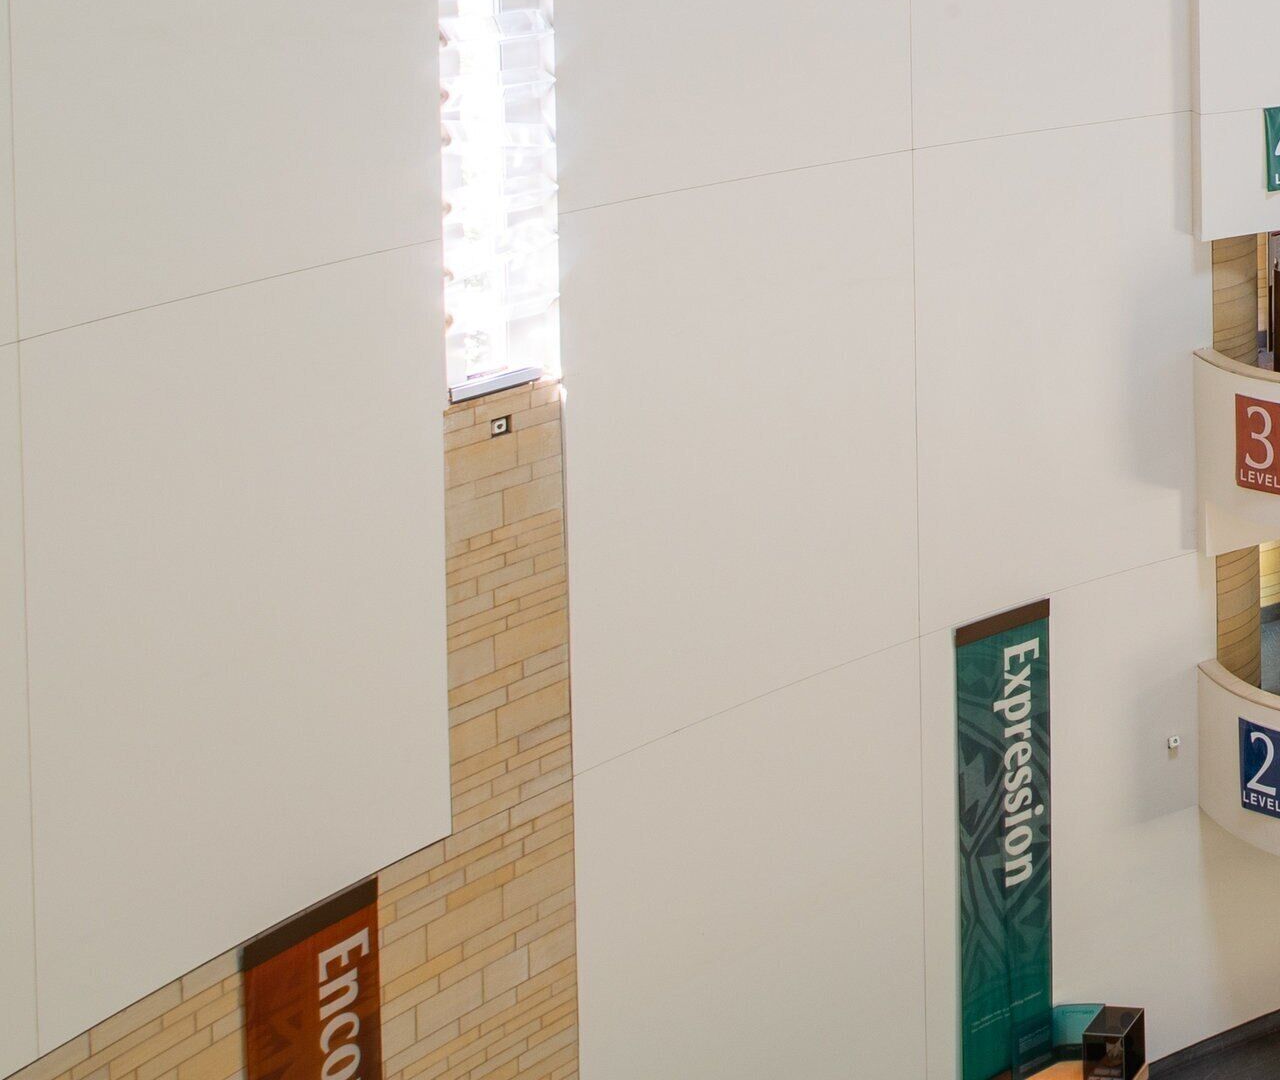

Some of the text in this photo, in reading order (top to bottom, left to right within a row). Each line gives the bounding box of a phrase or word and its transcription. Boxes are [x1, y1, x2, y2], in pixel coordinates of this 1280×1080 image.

[1245, 405, 1274, 469] 3
[1240, 468, 1280, 489] LEVEL
[993, 636, 1044, 889] Expression
[1246, 731, 1277, 797] 2
[318, 926, 370, 1080] Enco
